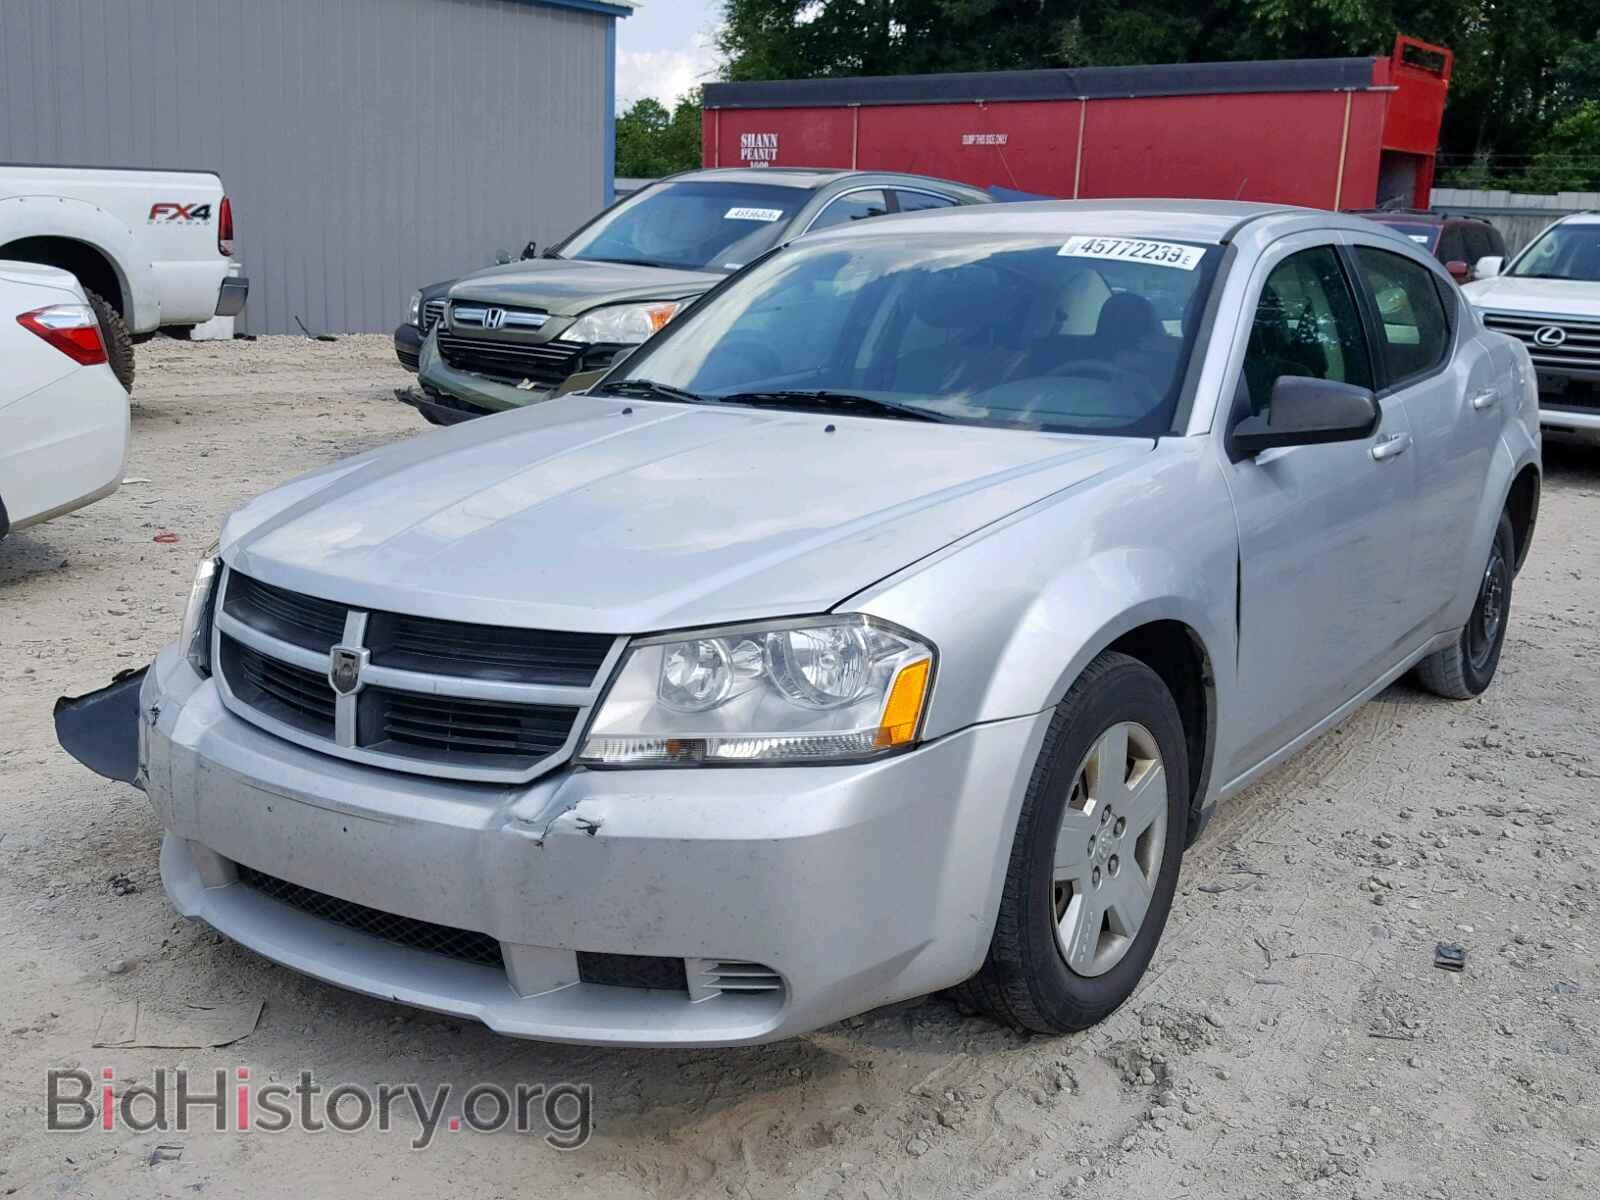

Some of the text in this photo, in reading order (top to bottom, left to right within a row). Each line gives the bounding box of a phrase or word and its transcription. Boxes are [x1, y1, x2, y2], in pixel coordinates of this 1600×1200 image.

[740, 133, 778, 148] SHANN
[740, 148, 778, 160] PEANUT
[149, 203, 211, 220] FX4
[1080, 237, 1184, 263] 45772239
